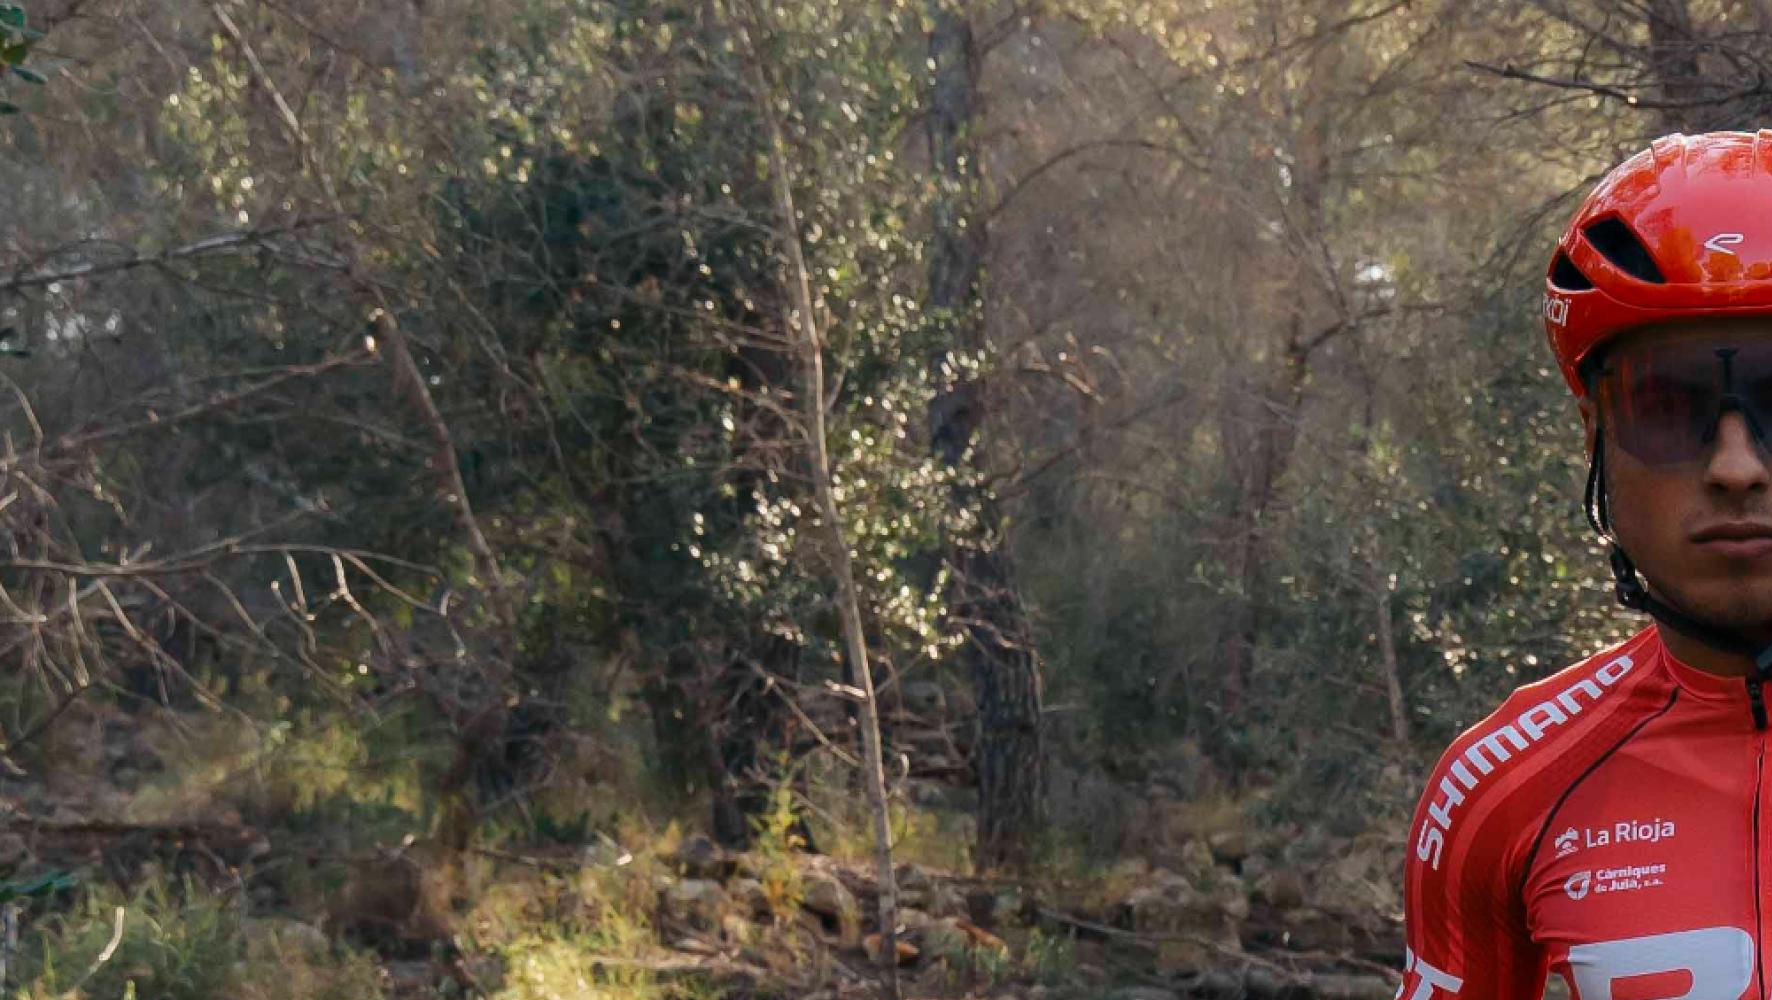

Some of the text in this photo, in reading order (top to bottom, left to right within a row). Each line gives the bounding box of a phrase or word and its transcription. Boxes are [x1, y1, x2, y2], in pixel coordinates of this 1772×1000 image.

[1416, 655, 1634, 871] SHIMANO
[1585, 818, 1676, 849] La Rioja
